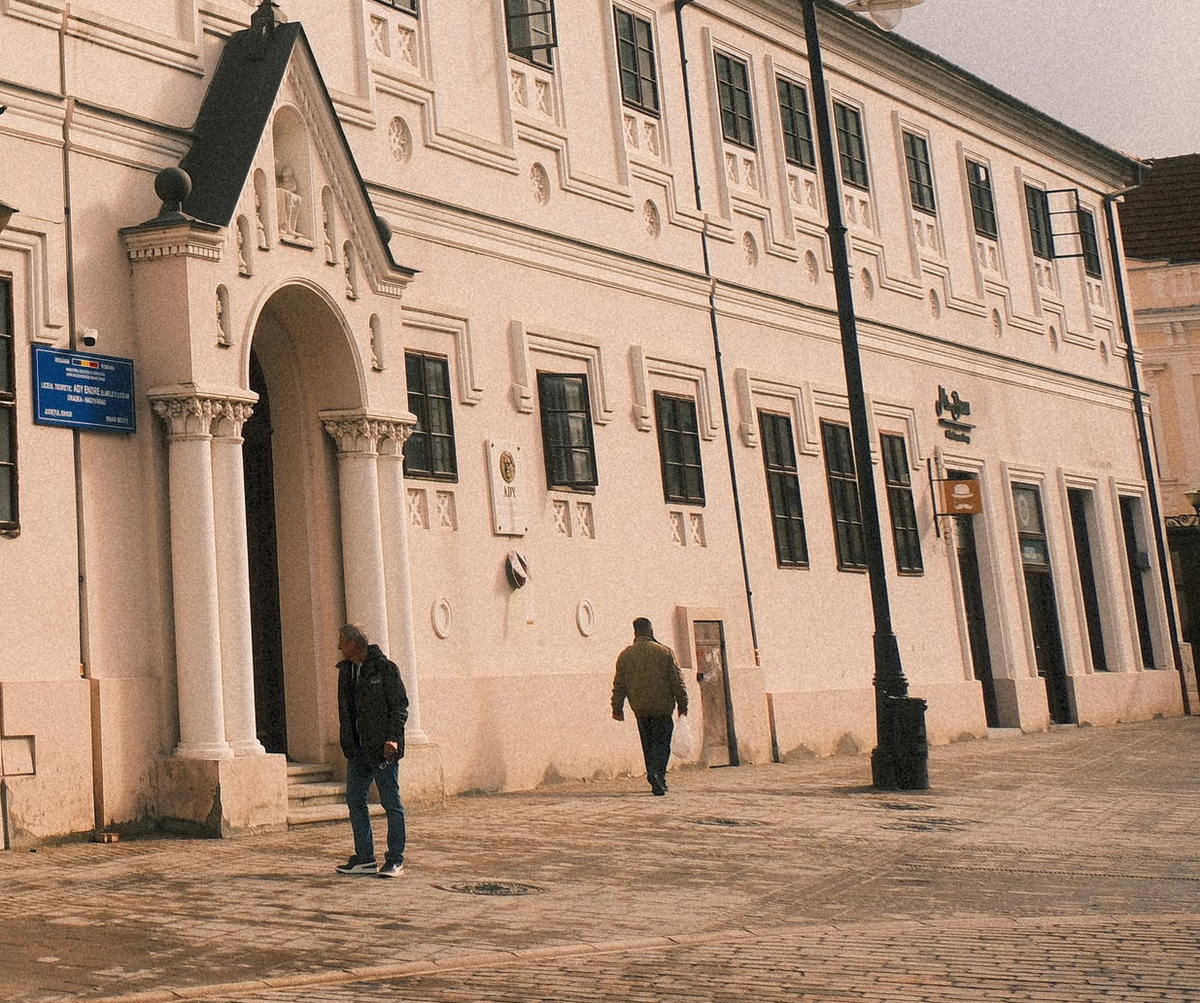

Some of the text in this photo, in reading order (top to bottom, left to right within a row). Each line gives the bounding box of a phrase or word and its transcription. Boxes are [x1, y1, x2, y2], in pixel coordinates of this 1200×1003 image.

[73, 384, 83, 393] ADY
[84, 385, 100, 395] ENDRE
[503, 485, 517, 498] ADY
